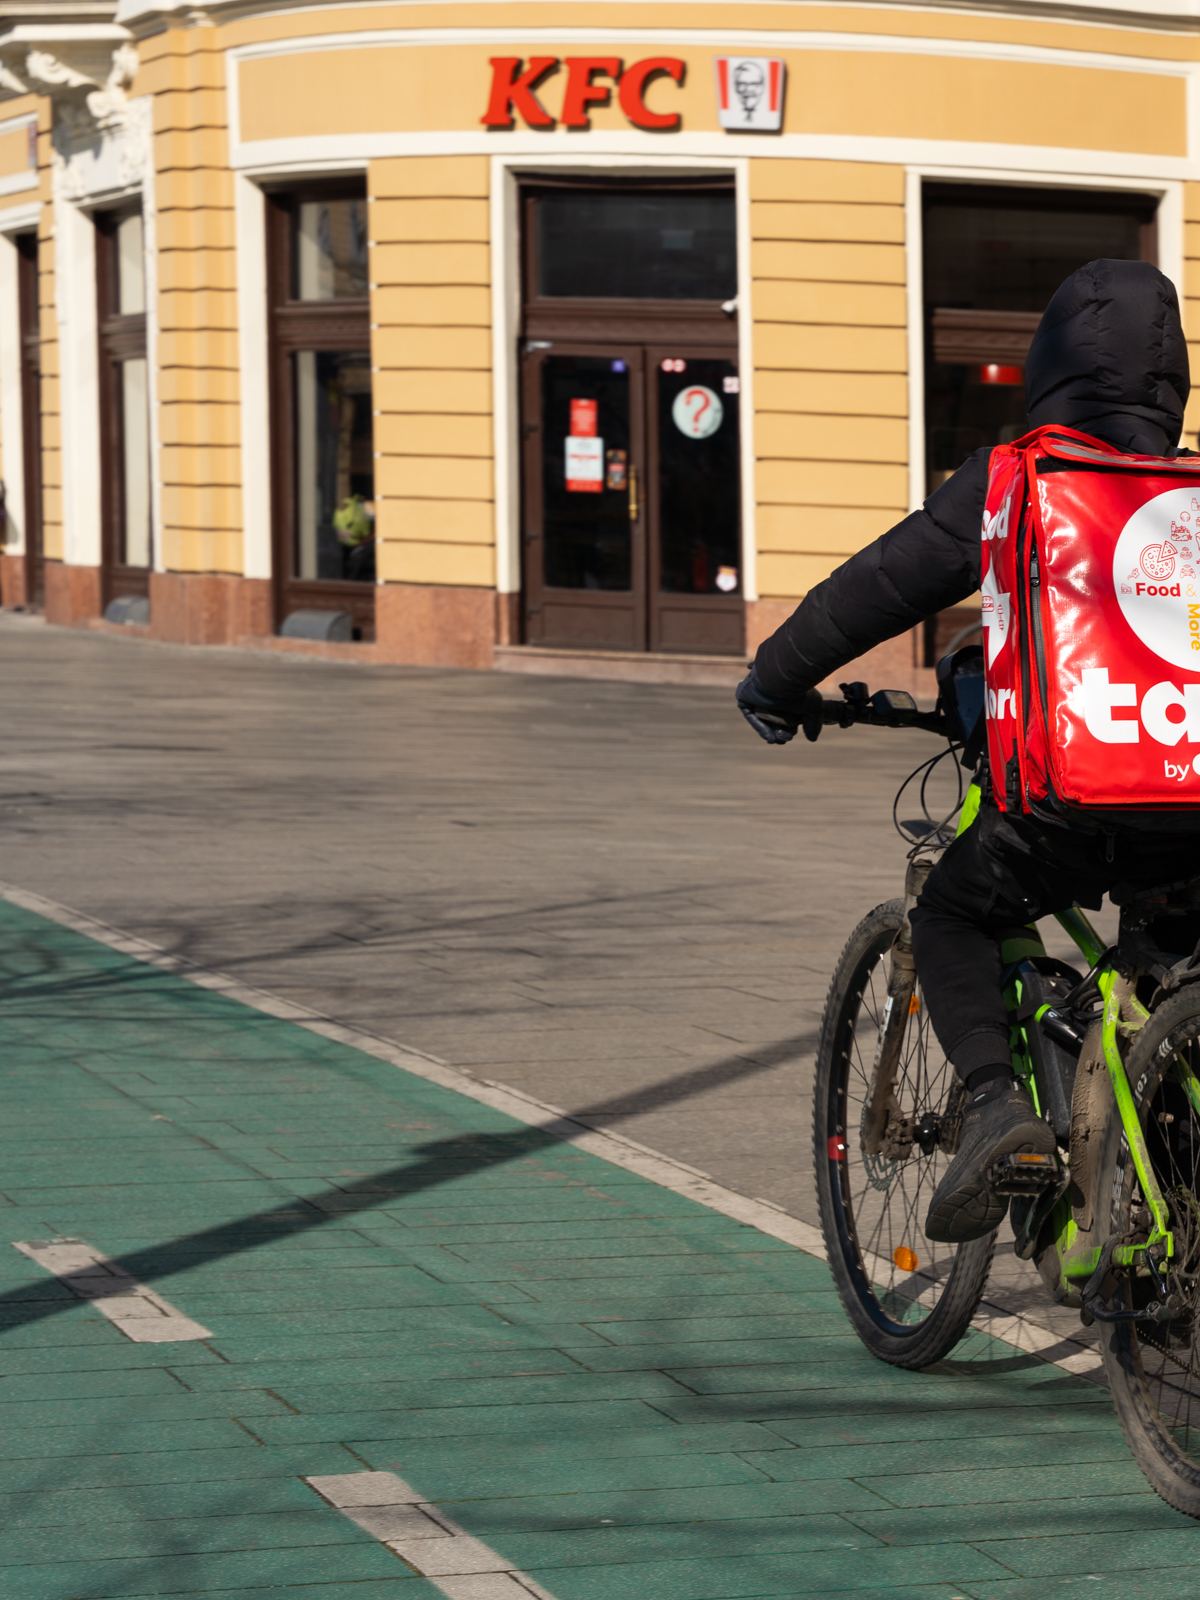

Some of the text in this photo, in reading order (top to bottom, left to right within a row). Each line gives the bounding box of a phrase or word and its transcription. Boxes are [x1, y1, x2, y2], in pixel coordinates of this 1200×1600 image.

[480, 56, 686, 129] KFC
[981, 496, 1011, 541] ood
[1135, 582, 1197, 597] Food &
[1164, 760, 1190, 782] by
